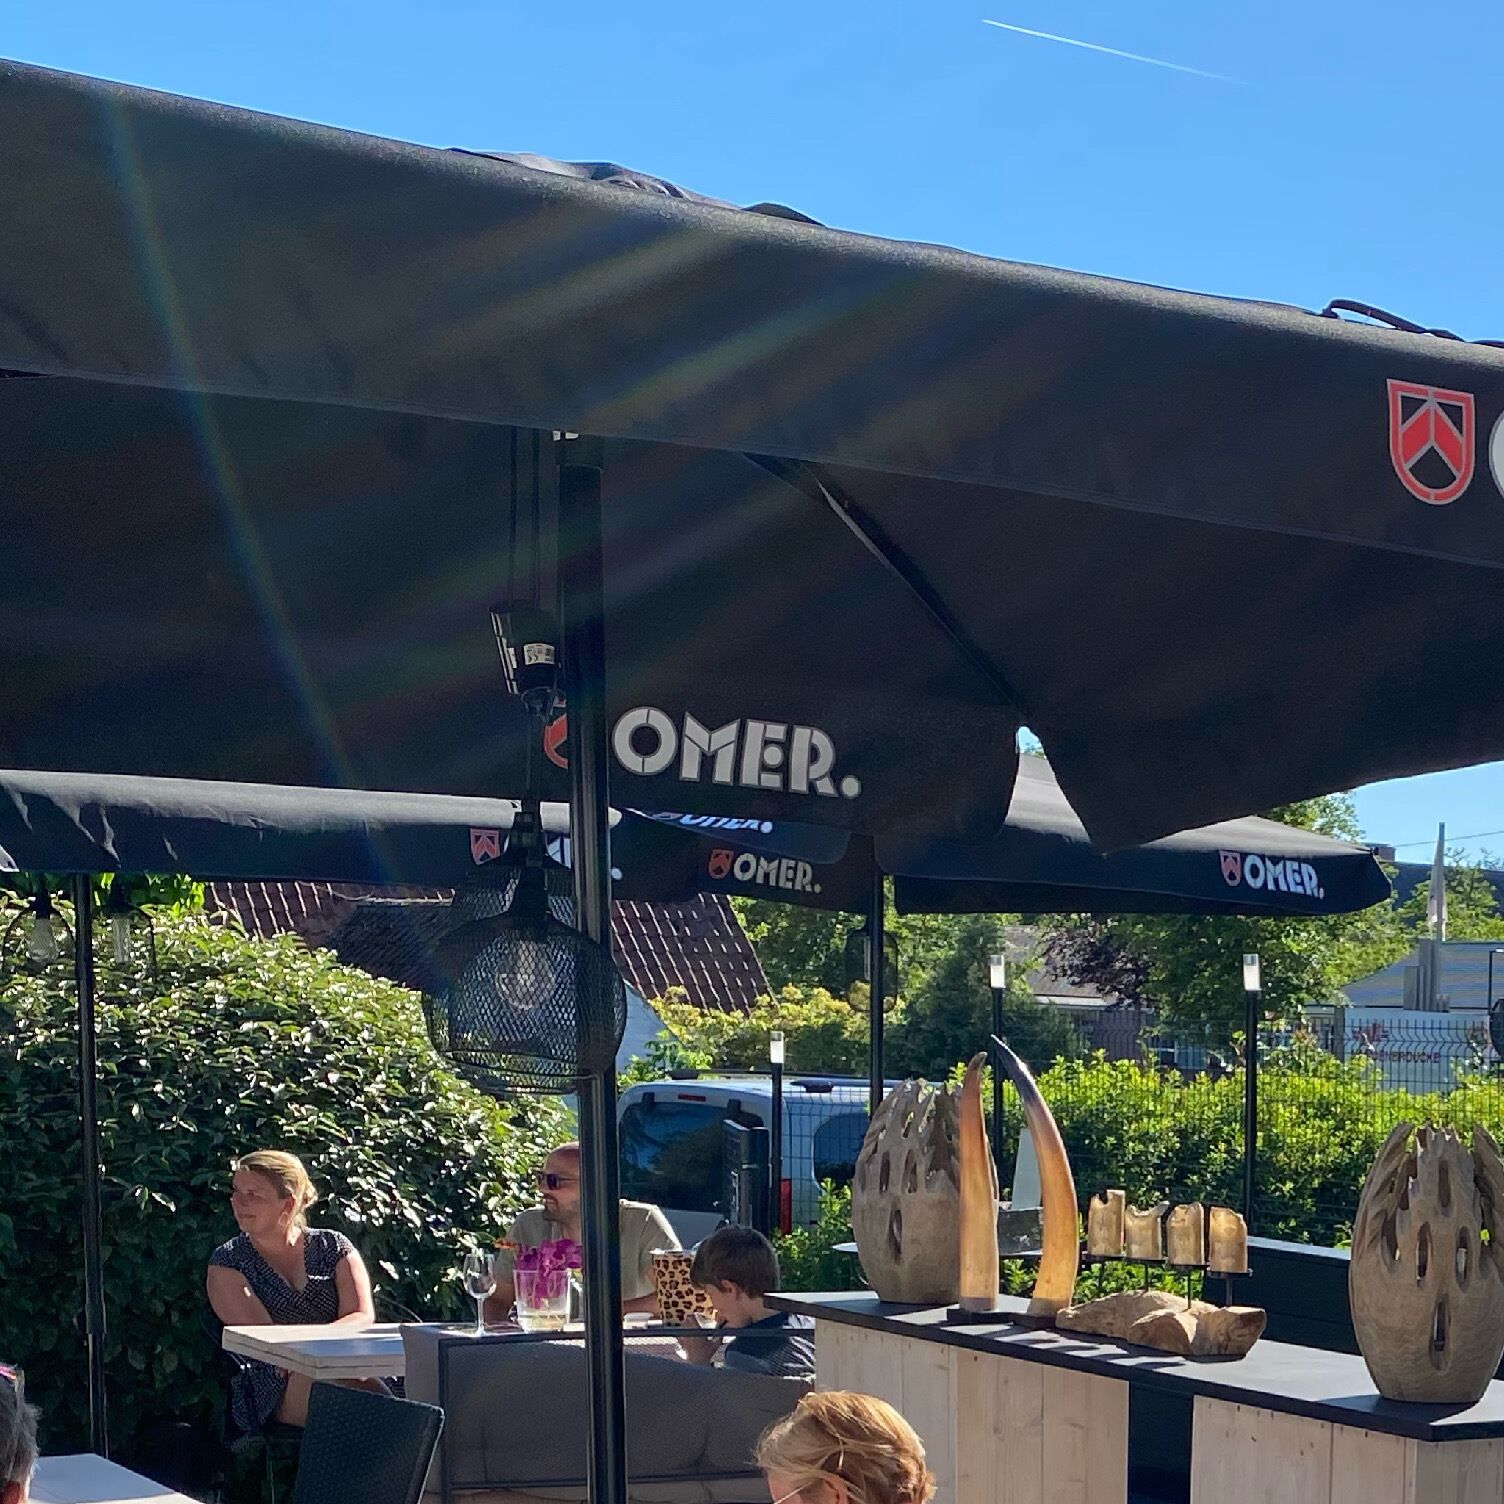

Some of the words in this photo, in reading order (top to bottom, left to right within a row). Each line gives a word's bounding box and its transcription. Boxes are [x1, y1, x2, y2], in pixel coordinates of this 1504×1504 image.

[611, 705, 862, 800] OMER.
[733, 852, 822, 894] OMER.
[1243, 854, 1325, 899] OMER.
